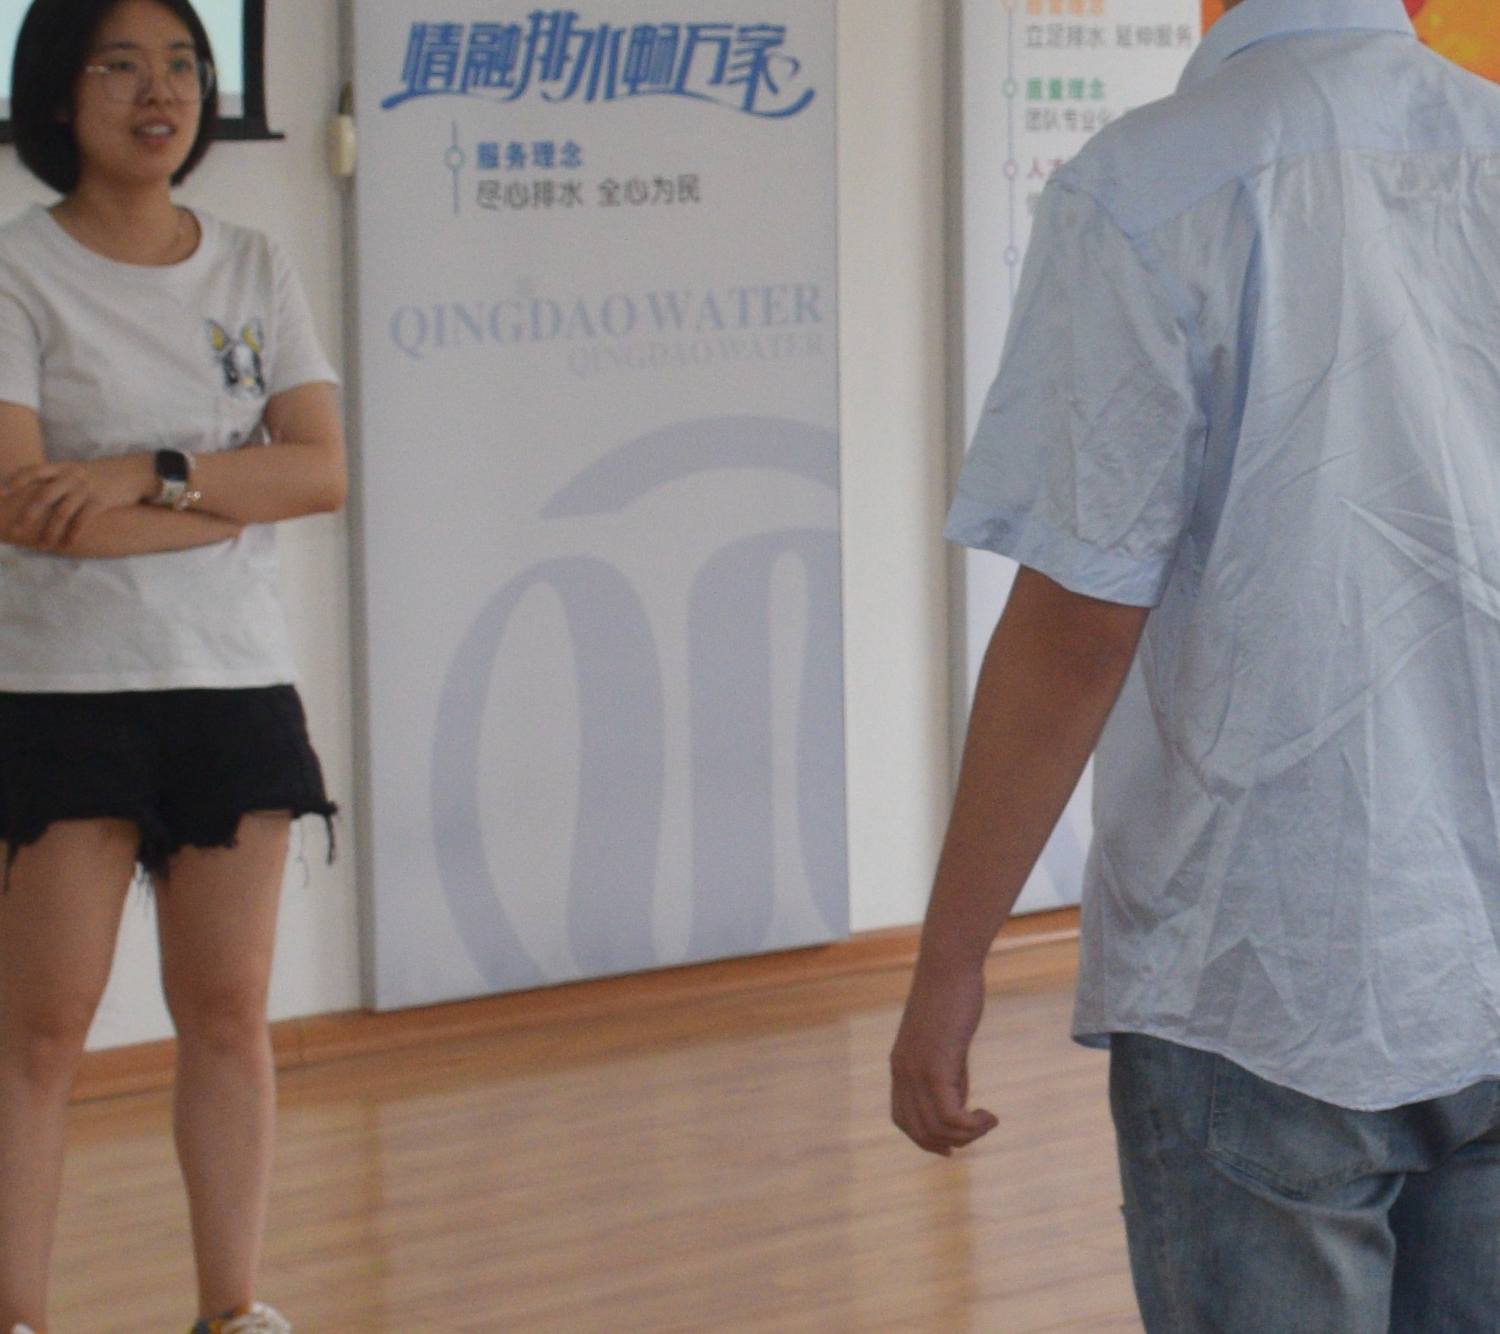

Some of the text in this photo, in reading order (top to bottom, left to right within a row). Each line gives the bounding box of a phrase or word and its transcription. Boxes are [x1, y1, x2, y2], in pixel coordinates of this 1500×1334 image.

[476, 140, 584, 170] 服务理念
[476, 174, 702, 211] 尽心排水 全心为民
